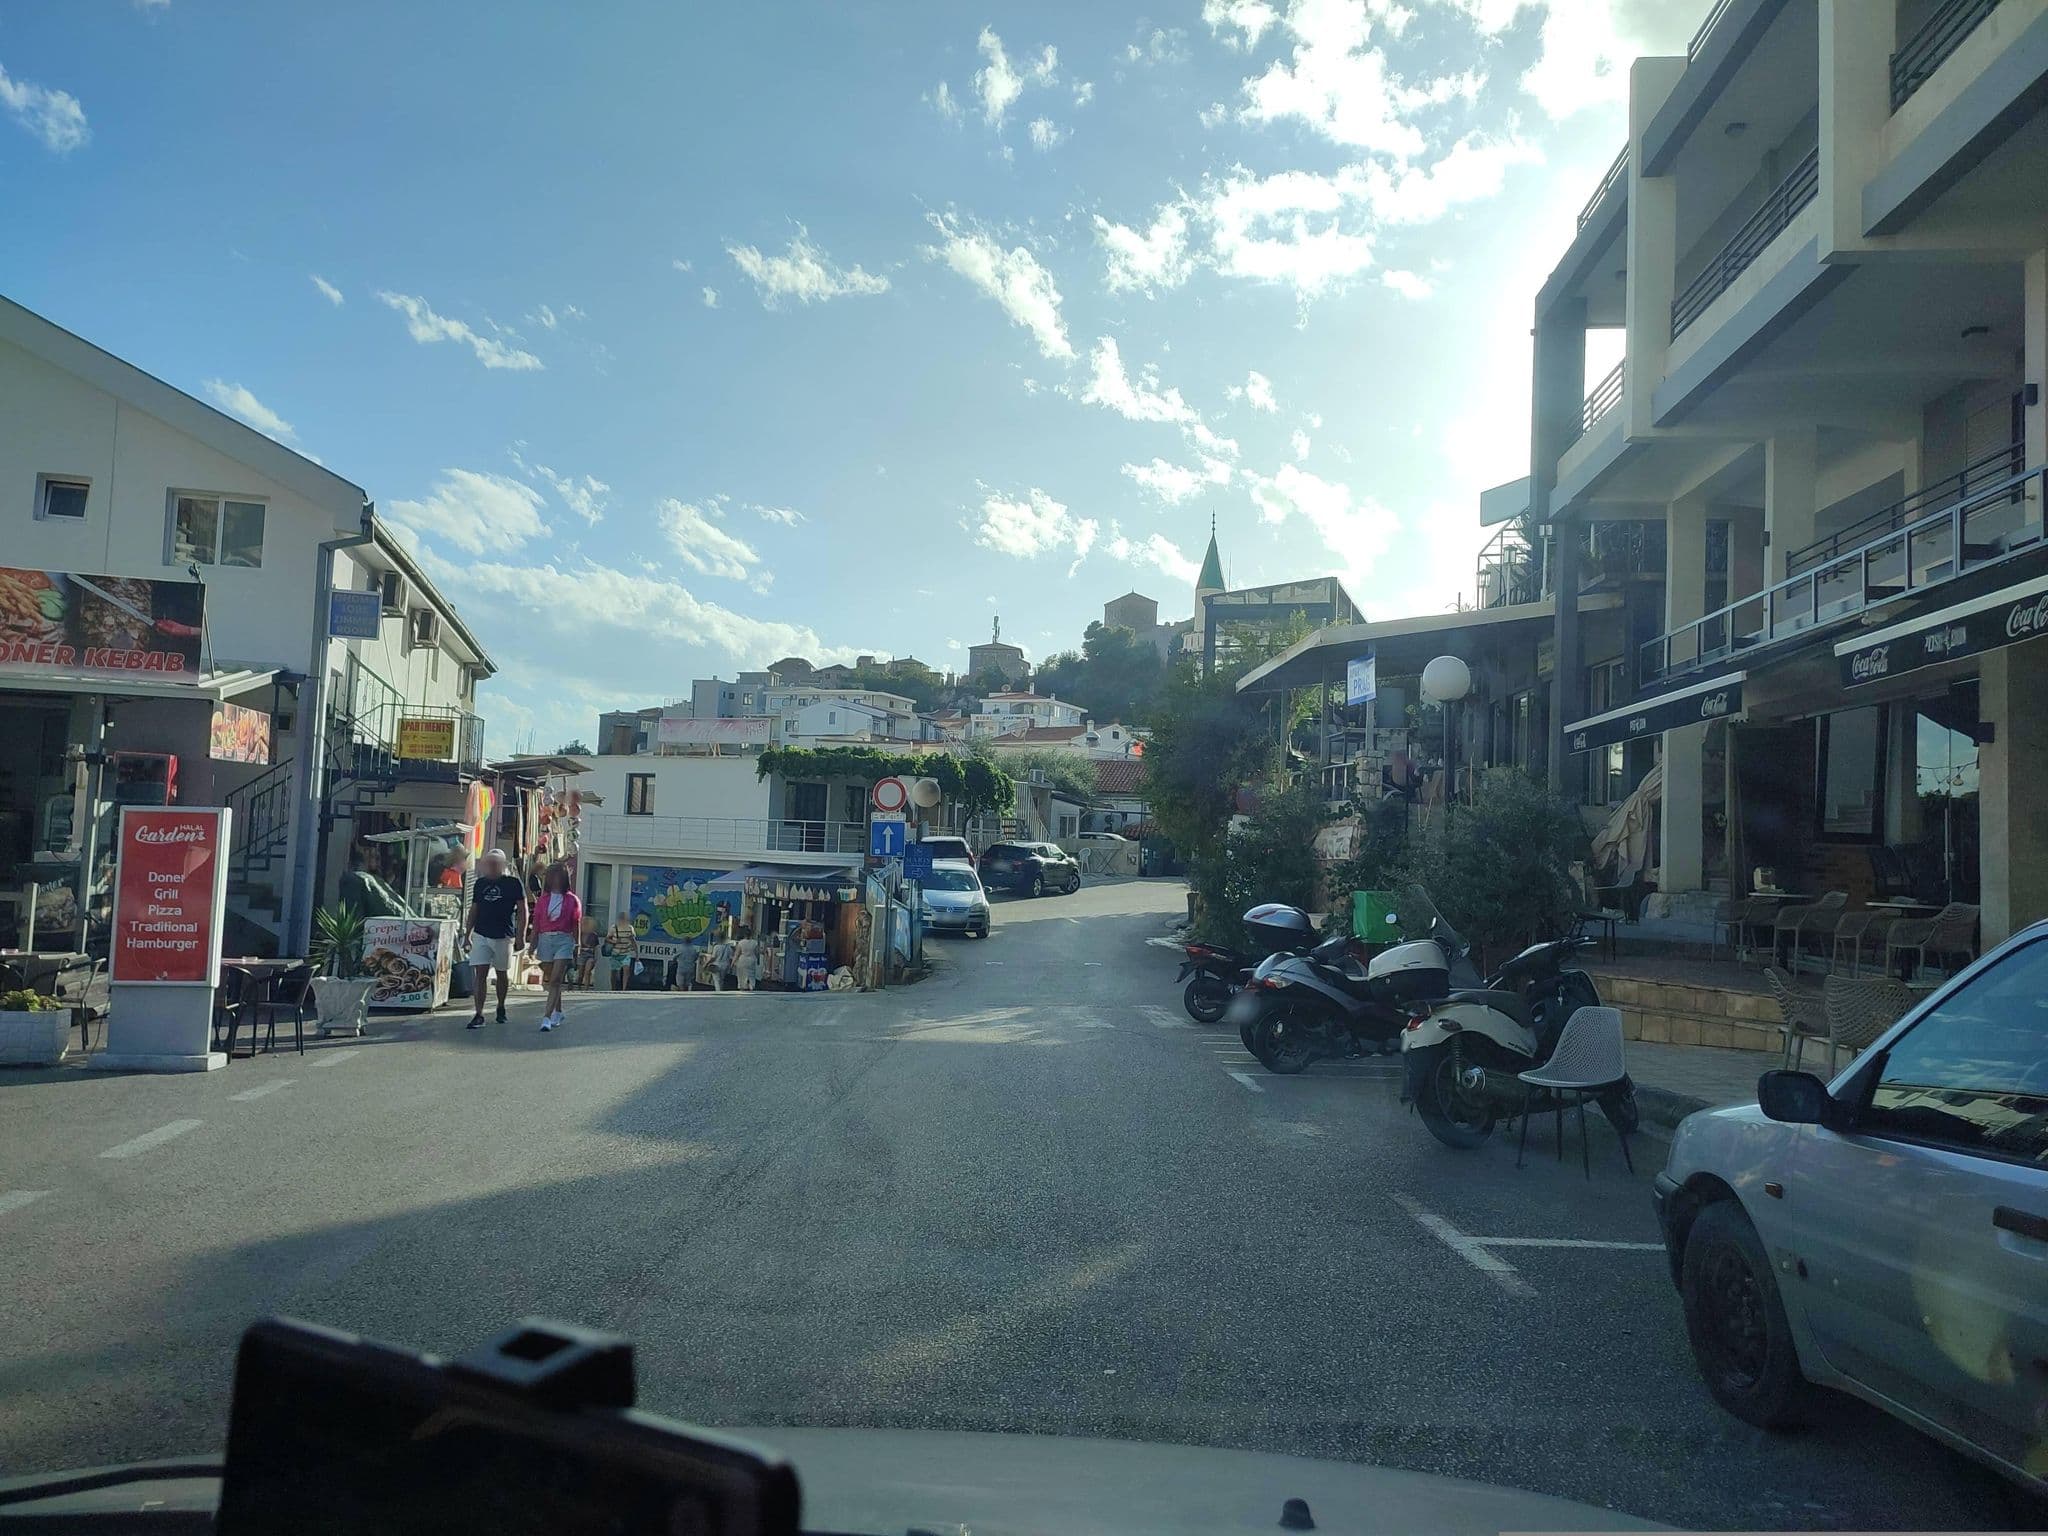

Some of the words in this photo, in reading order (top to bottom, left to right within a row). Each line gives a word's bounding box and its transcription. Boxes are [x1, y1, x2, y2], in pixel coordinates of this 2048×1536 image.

[84, 647, 185, 672] KEBAB
[148, 871, 185, 883] Doner
[154, 888, 178, 900] Grill
[148, 904, 182, 916] Pizza
[129, 921, 198, 933] Traditional
[126, 937, 199, 952] Hamburger
